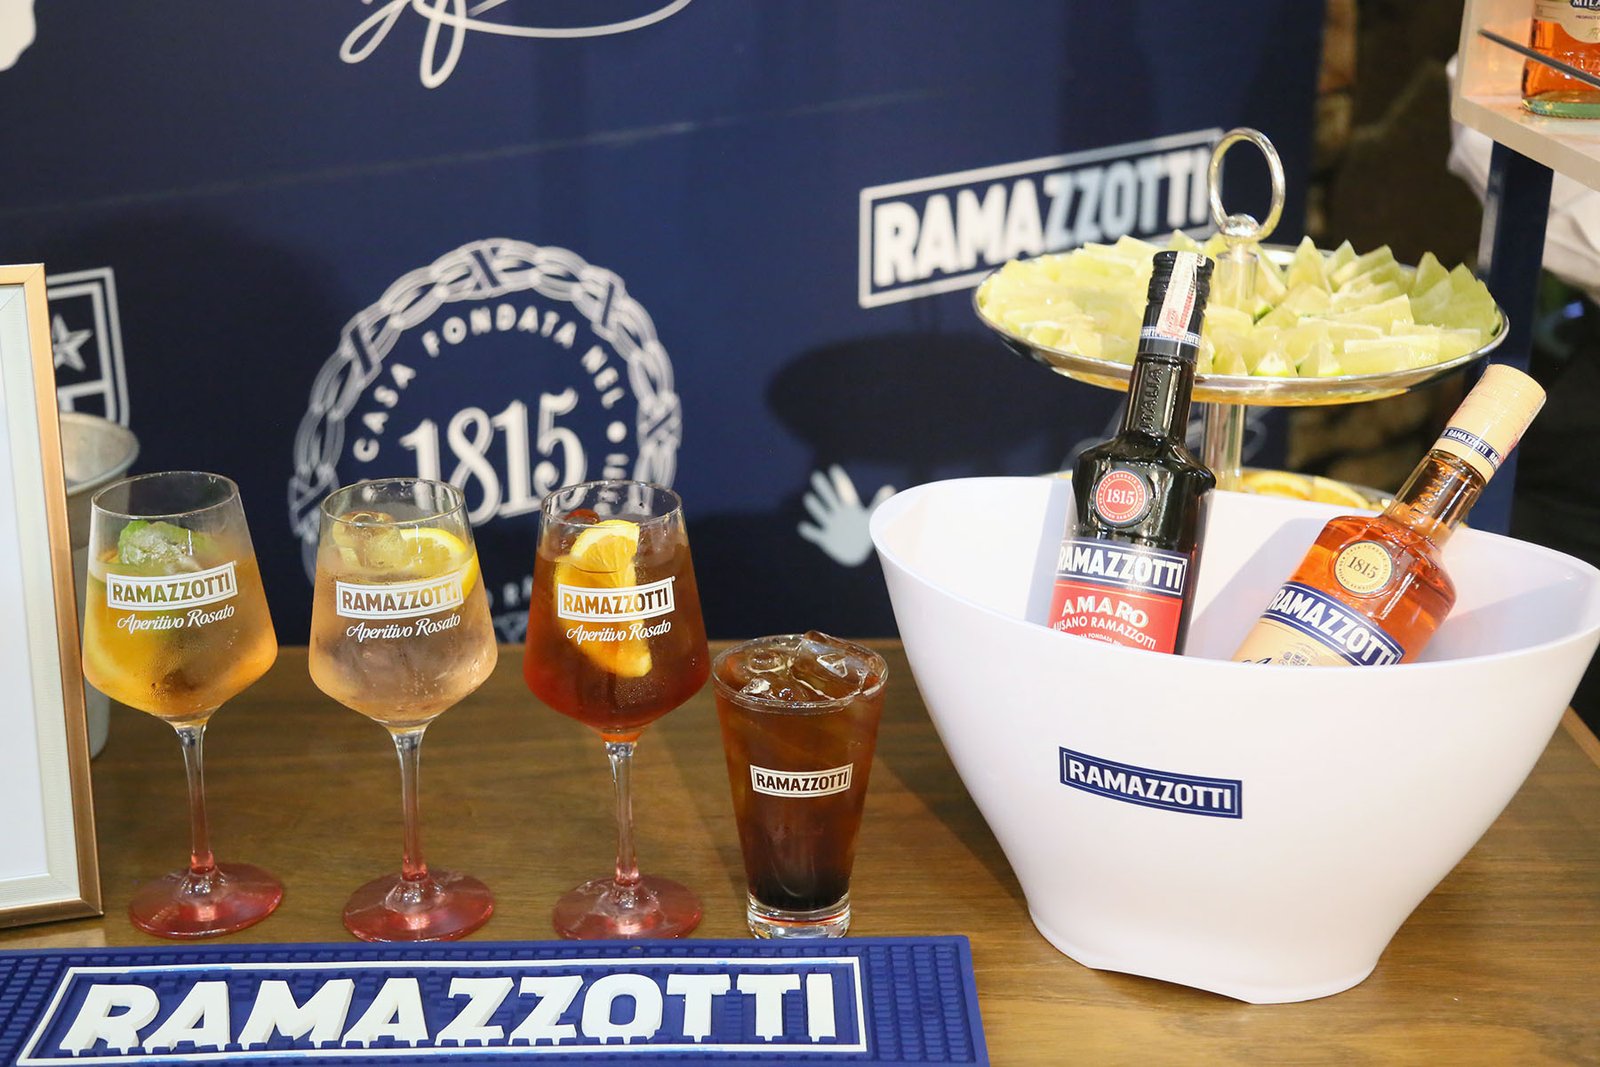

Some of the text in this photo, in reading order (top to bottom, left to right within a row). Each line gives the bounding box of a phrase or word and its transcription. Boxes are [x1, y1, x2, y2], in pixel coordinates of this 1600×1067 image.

[873, 146, 1212, 287] RAMAZZOTTI
[353, 362, 416, 463] CASA
[421, 303, 578, 358] FONDATA
[1139, 367, 1164, 431] ITALIA
[399, 387, 588, 526] 1815
[1447, 429, 1490, 455] RAMAZZOTTI
[1106, 488, 1135, 505] 1815
[1056, 546, 1184, 589] RAMAZZOTTI
[1347, 556, 1379, 579] 1815
[113, 572, 231, 603] RAMAZZOTTI
[342, 582, 458, 612] RAMAZZOTTI
[563, 587, 669, 615] RAMAZZOTTI
[117, 604, 235, 635] Aperitivo Rosato
[1061, 595, 1149, 628] AMARO
[1267, 588, 1401, 666] RAMAZZOTTI
[346, 613, 461, 643] Aperitivo Rosato
[566, 619, 672, 645] Aperitivo Rosato
[1091, 616, 1157, 650] RAMAZZOTTI
[755, 771, 848, 792] RAMAZZOTTI
[1068, 759, 1232, 810] RAMAZZOTTI
[59, 972, 839, 1057] RAMAZZOTTI
